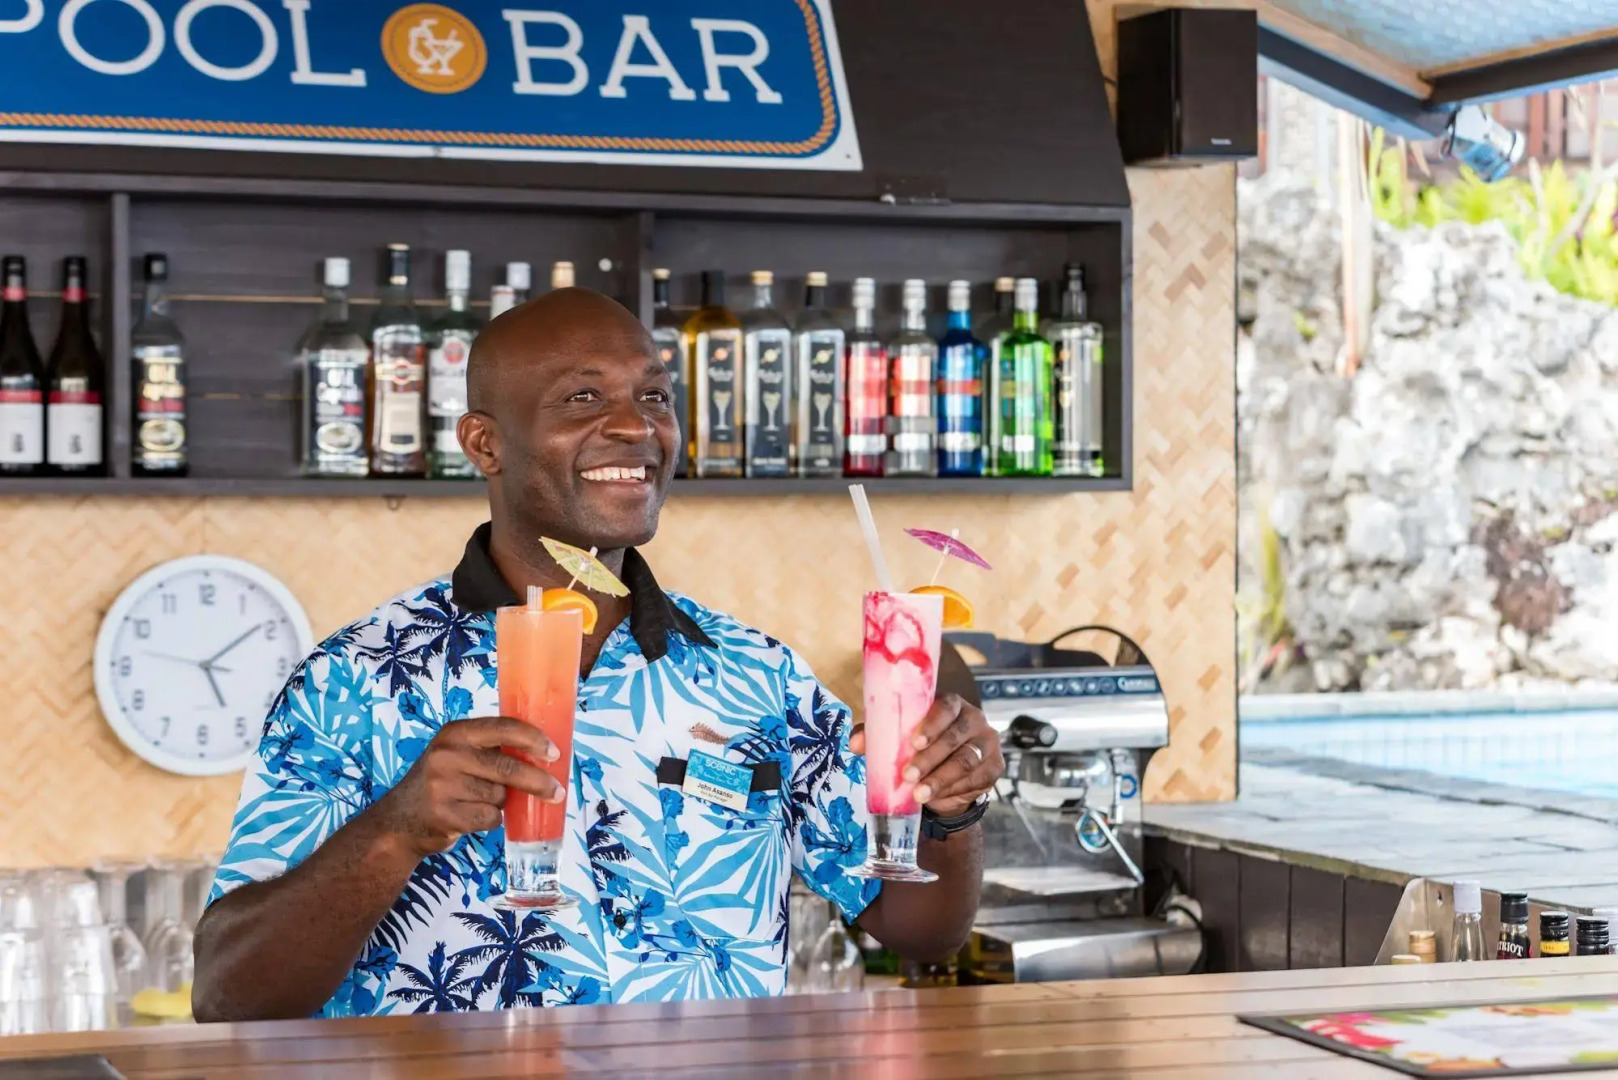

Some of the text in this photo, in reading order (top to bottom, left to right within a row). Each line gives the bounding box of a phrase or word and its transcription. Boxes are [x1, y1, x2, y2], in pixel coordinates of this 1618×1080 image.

[502, 9, 782, 103] BAR
[161, 593, 177, 615] 11
[199, 584, 216, 605] 12
[264, 619, 277, 641] 2
[160, 715, 171, 739] 7
[697, 783, 711, 792] John
